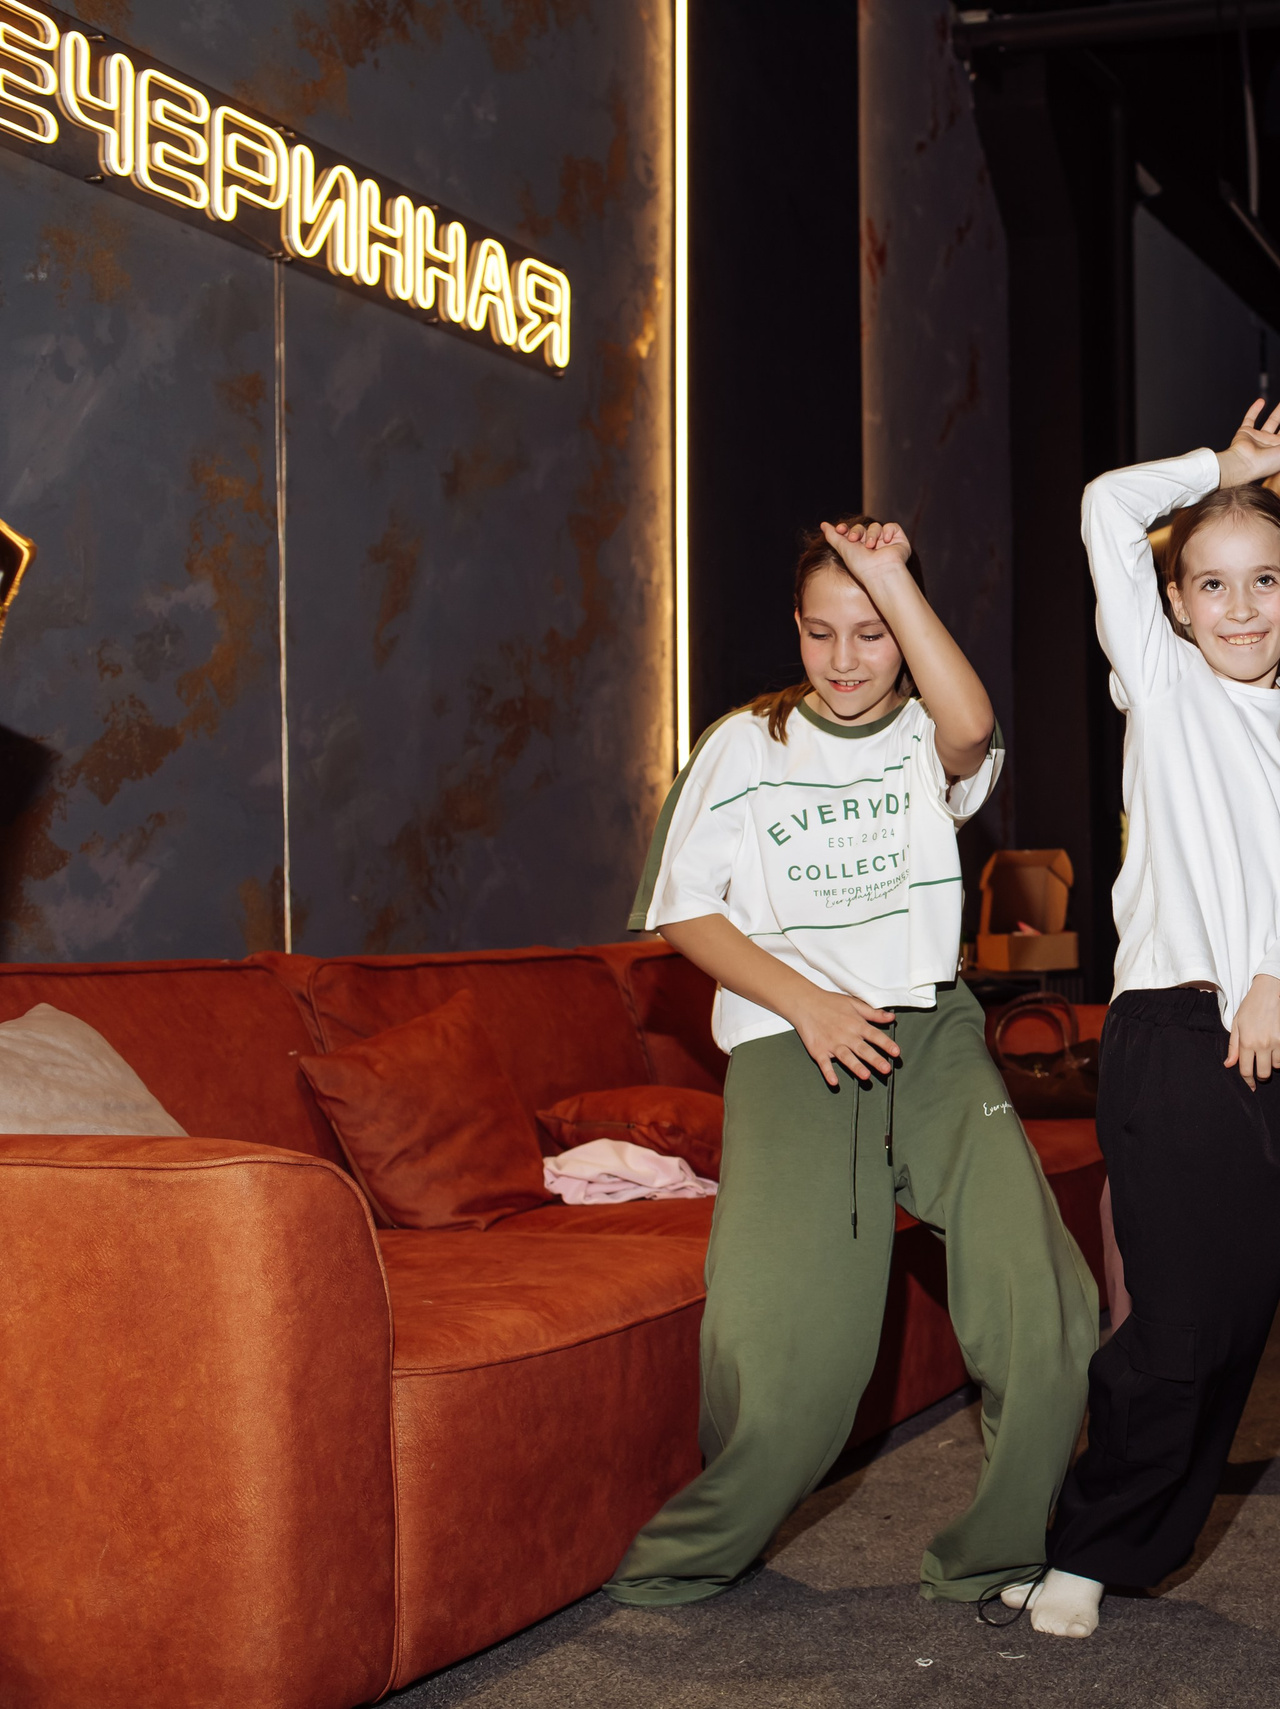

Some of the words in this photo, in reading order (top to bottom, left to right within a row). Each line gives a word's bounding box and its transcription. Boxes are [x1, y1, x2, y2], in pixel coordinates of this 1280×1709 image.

[787, 843, 910, 882] COLLECTI
[813, 888, 838, 897] TIME
[842, 886, 862, 896] FOR
